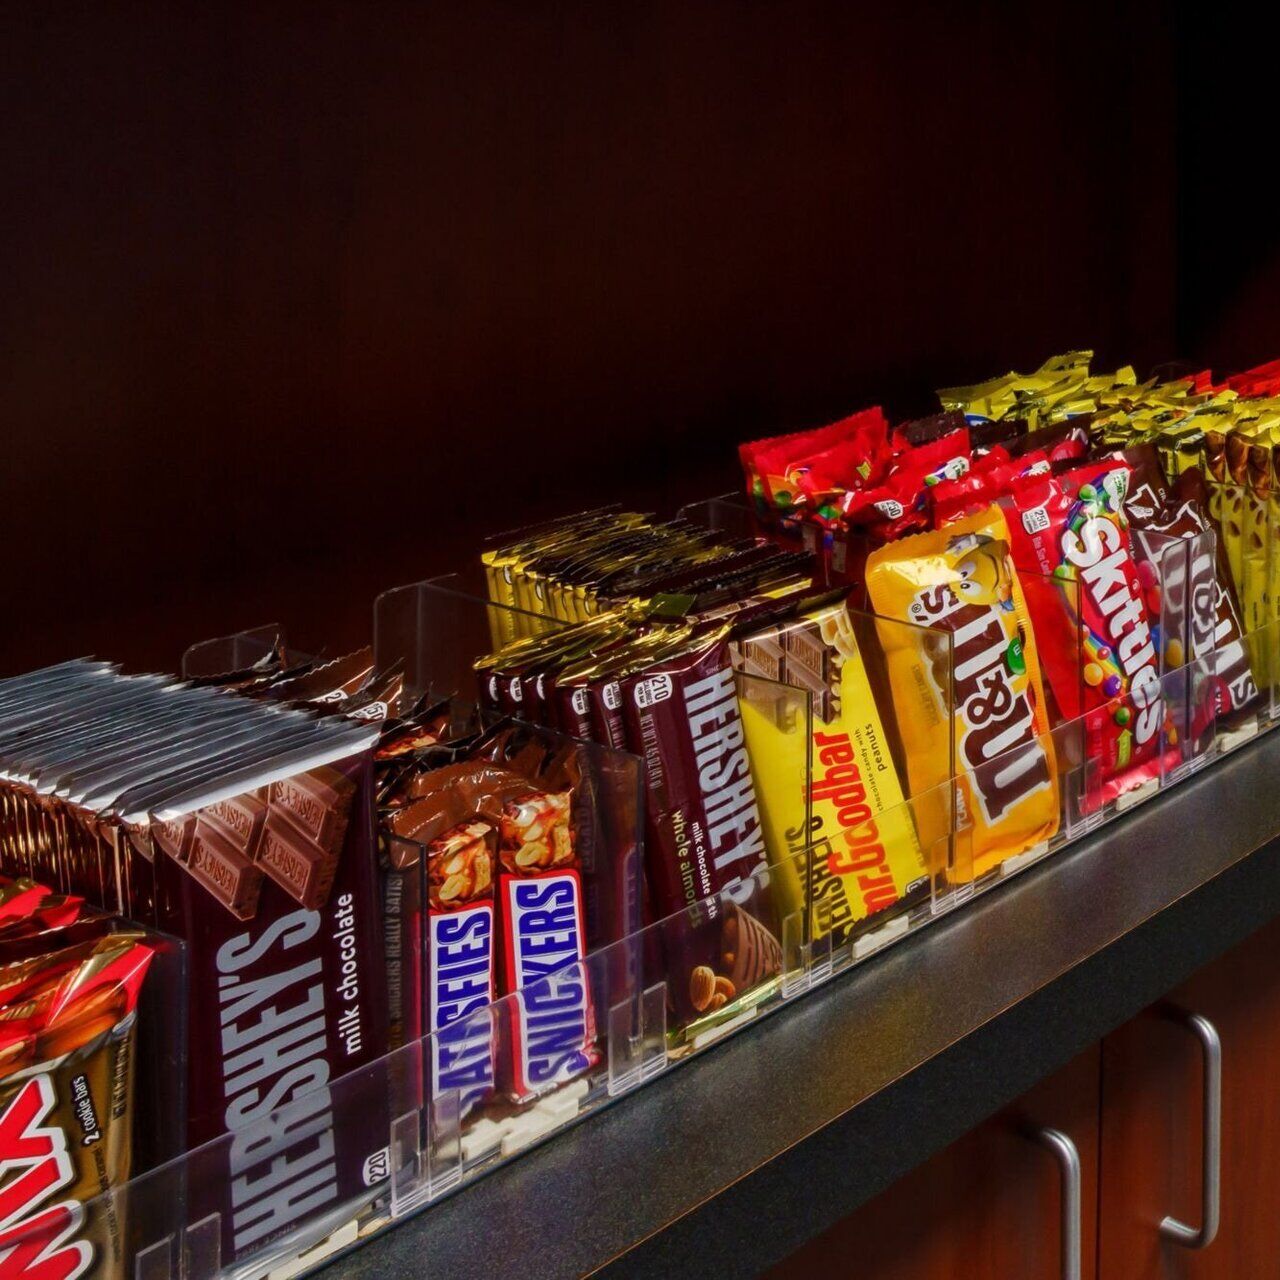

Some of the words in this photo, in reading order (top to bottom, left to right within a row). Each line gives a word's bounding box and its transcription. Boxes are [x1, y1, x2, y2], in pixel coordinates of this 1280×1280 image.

[1034, 509, 1048, 528] 250
[1060, 516, 1164, 747] Skittles
[650, 674, 670, 702] 210
[853, 727, 866, 748] with
[863, 722, 889, 772] peanuts
[860, 747, 874, 772] candy
[682, 666, 771, 906] HERSHEY'S
[867, 771, 885, 812] chocolate
[669, 809, 692, 858] whole
[690, 821, 706, 844] milk
[696, 845, 713, 896] chocolate
[383, 871, 402, 915] SATIS
[704, 896, 719, 920] wth
[332, 892, 360, 1002] chocolate
[384, 917, 402, 959] REALLY
[515, 879, 592, 1086] SNICKERS
[338, 1003, 362, 1056] milk
[71, 1074, 88, 1099] bars
[215, 906, 339, 1251] HERSHEY'S
[74, 1099, 97, 1132] cookie
[84, 1130, 102, 1147] 2
[369, 1150, 388, 1184] 220
